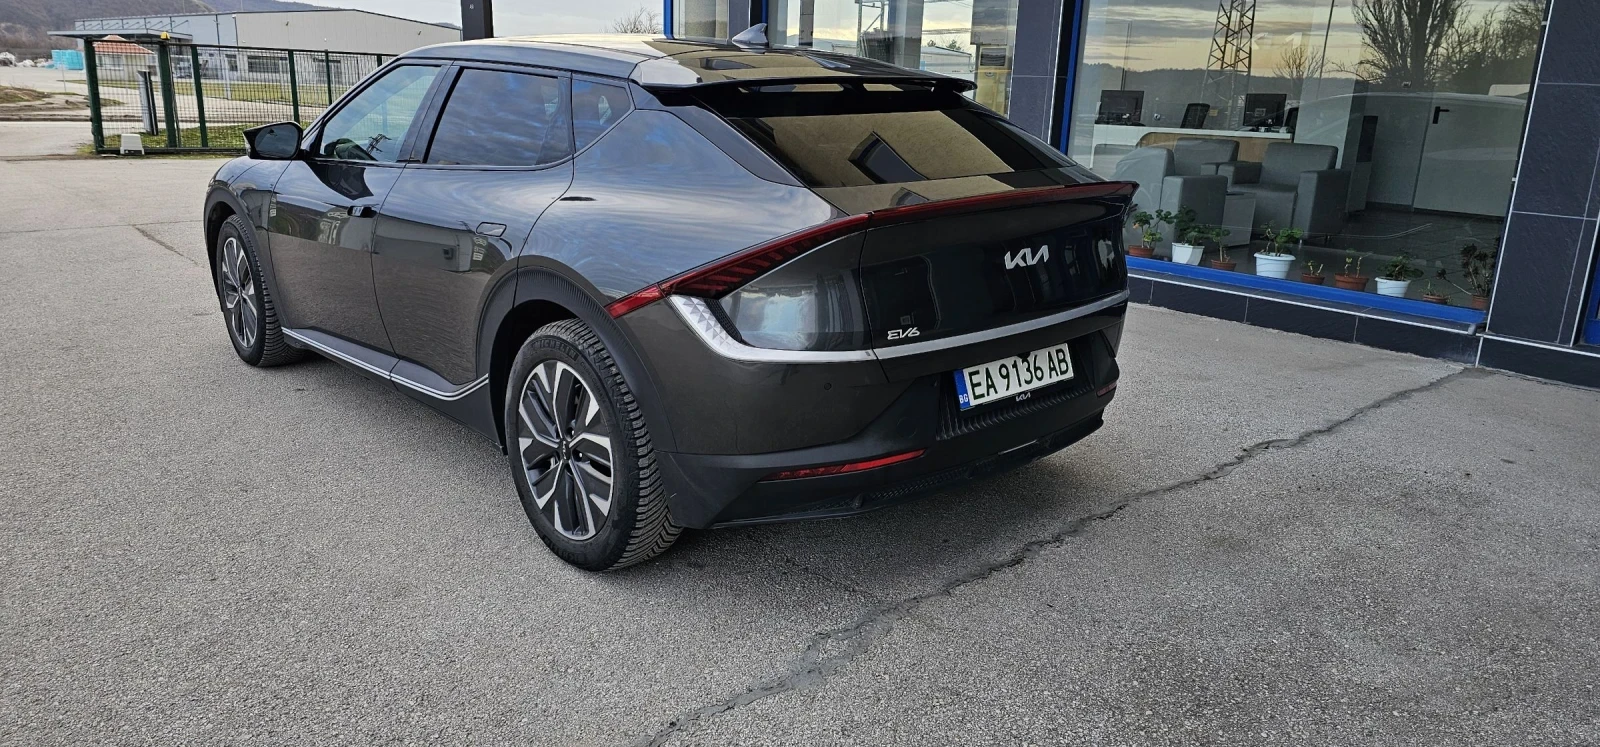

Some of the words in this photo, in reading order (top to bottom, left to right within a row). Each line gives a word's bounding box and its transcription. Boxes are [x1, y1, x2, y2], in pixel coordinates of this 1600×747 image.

[1004, 244, 1050, 270] KIA
[887, 327, 920, 340] EV6
[968, 367, 998, 401] EA
[998, 354, 1044, 391] 9136
[1047, 348, 1069, 379] AB
[959, 393, 969, 404] BG
